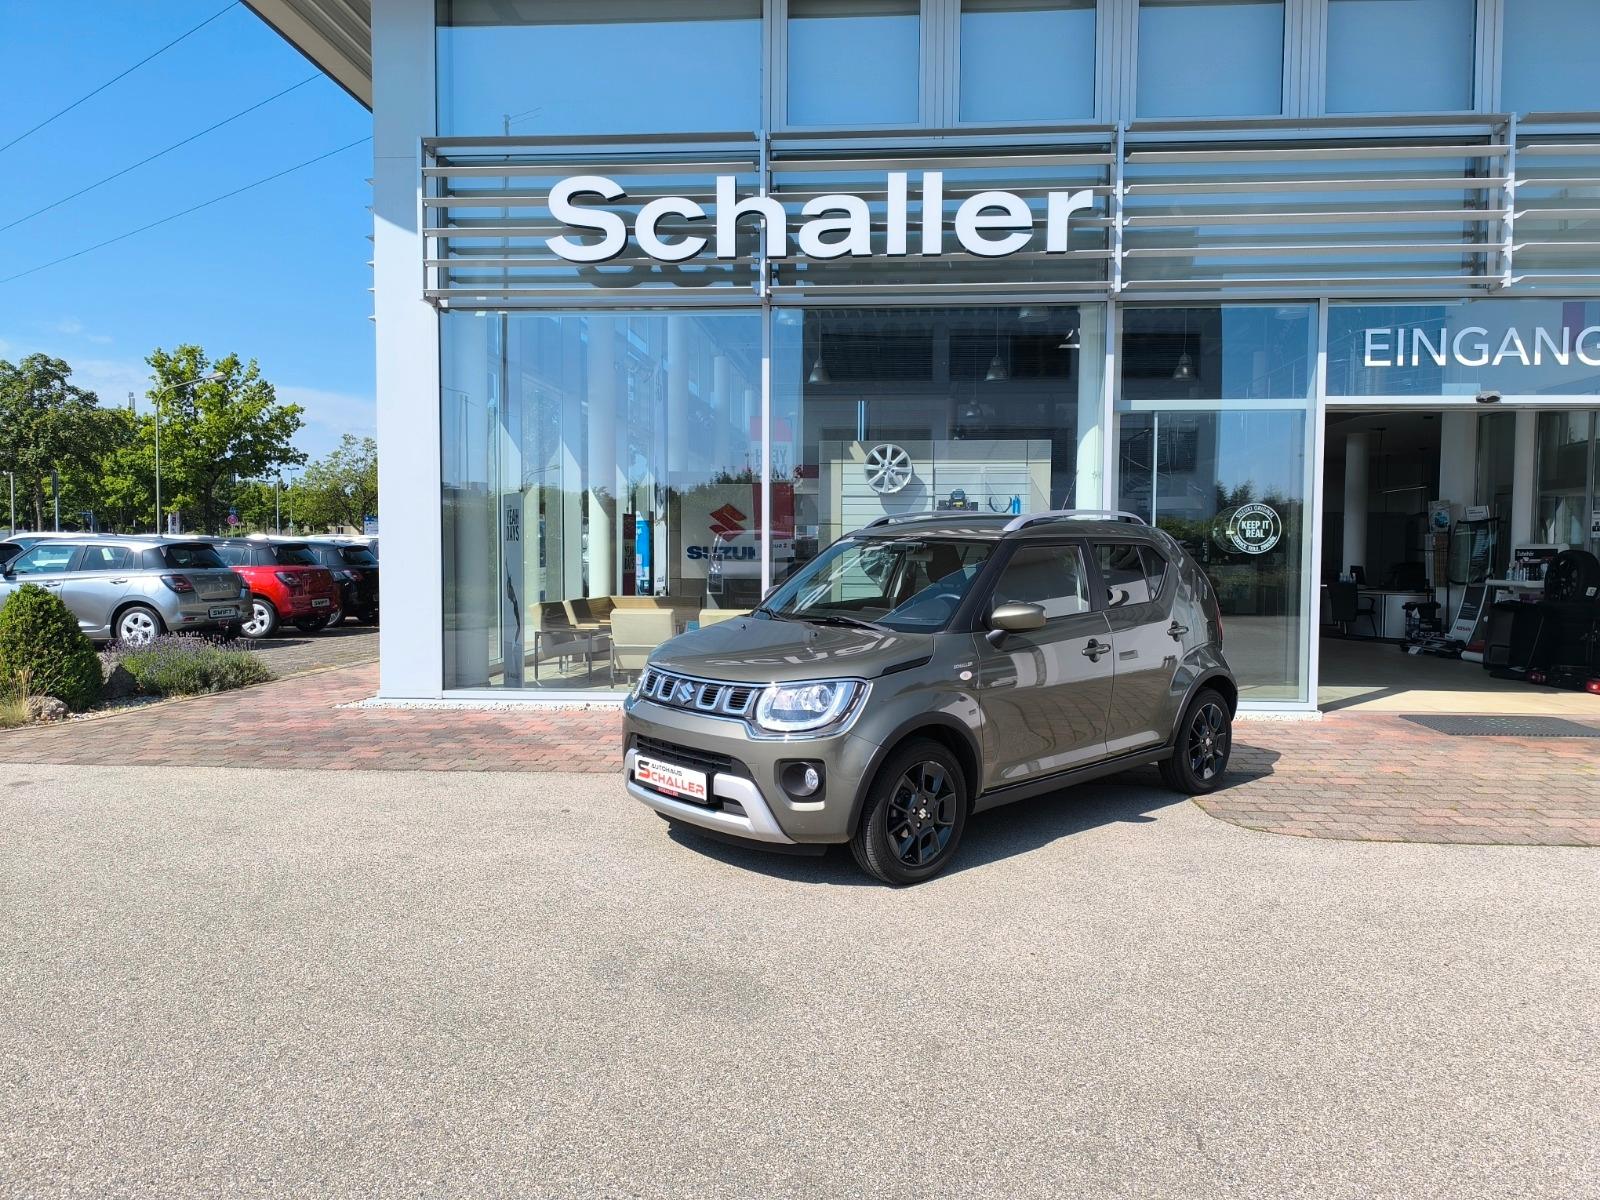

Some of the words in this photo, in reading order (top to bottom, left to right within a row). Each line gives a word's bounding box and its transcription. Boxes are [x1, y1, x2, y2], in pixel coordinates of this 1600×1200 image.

[545, 172, 1094, 261] Schaller
[1364, 326, 1600, 367] EINGANG
[1242, 521, 1260, 530] KEEP
[1262, 521, 1270, 530] IT
[1245, 529, 1265, 538] REAL
[212, 608, 233, 616] SWIFT
[651, 763, 683, 777] AUTOHAUS
[638, 760, 705, 796] SCHALLER
